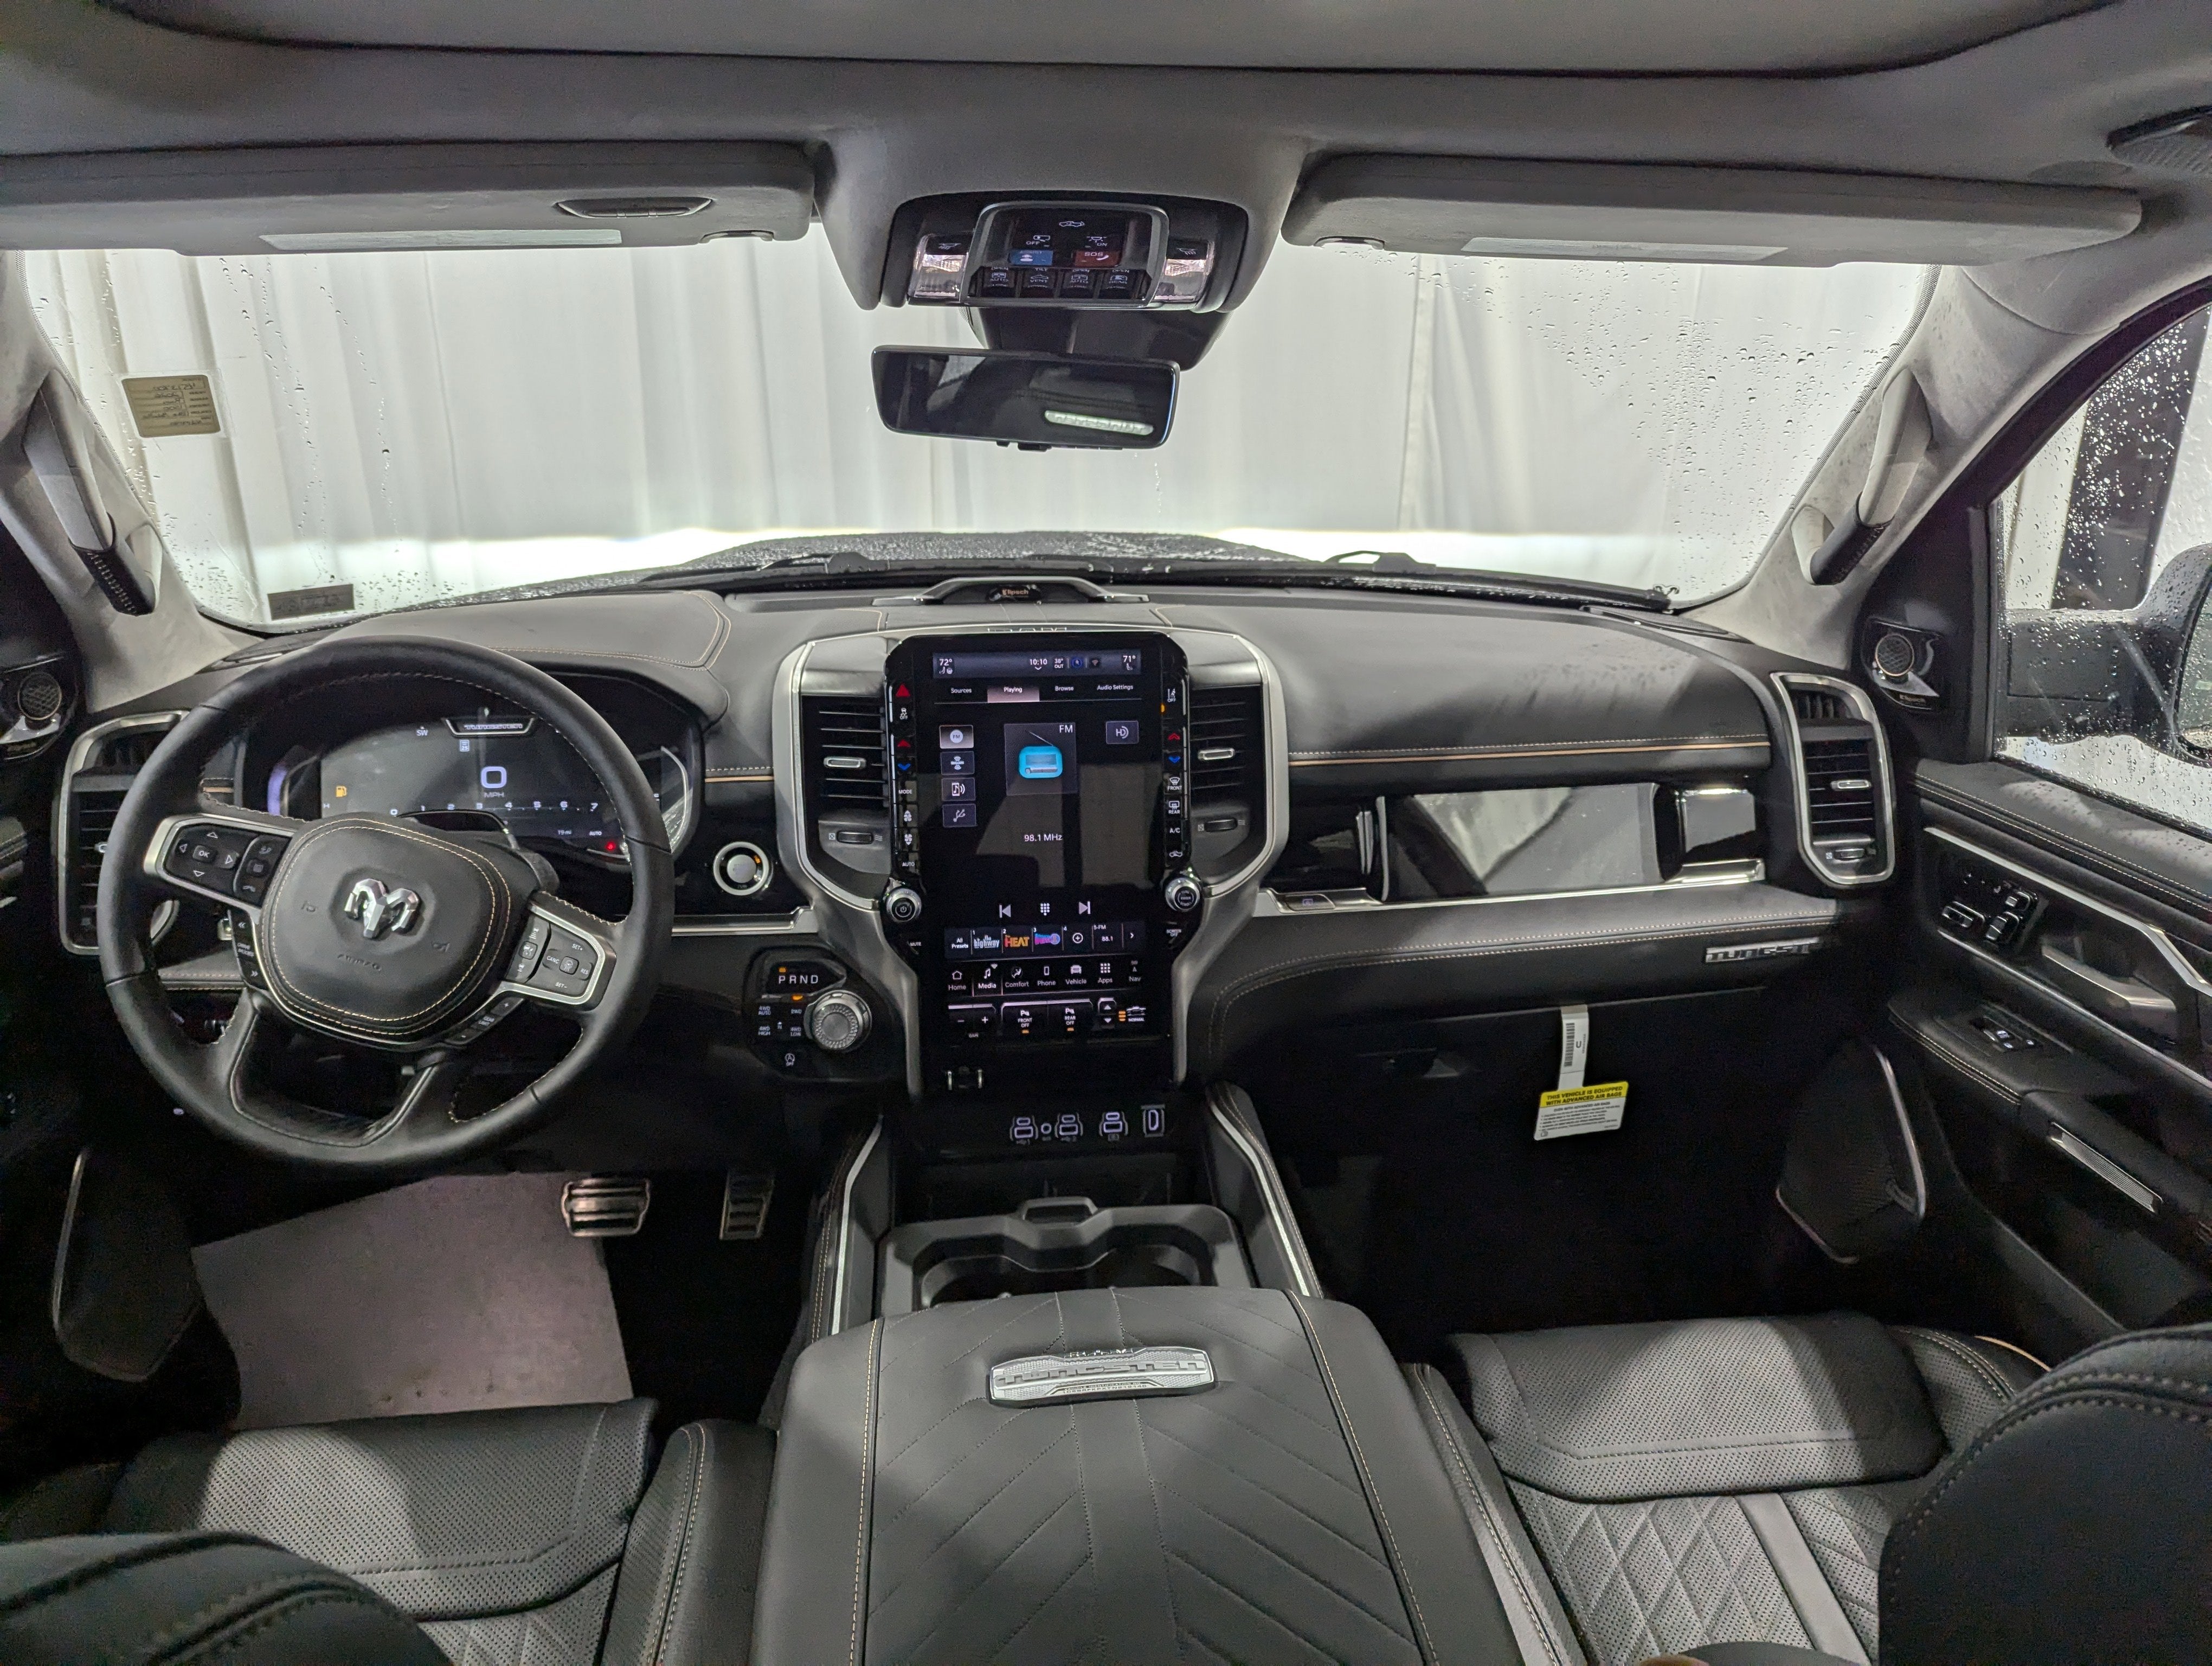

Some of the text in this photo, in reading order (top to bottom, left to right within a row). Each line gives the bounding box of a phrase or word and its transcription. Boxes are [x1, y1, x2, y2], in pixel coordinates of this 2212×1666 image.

[939, 658, 953, 666] 72°
[1123, 655, 1136, 663] 71°
[1059, 725, 1073, 733] FM
[481, 766, 507, 789] 0
[198, 849, 210, 858] OK
[974, 938, 1000, 949] highway
[1005, 936, 1030, 947] HEAT
[546, 956, 560, 964] CANC
[779, 975, 819, 984] P R N D
[998, 1360, 1207, 1385] TUNGSTEN
